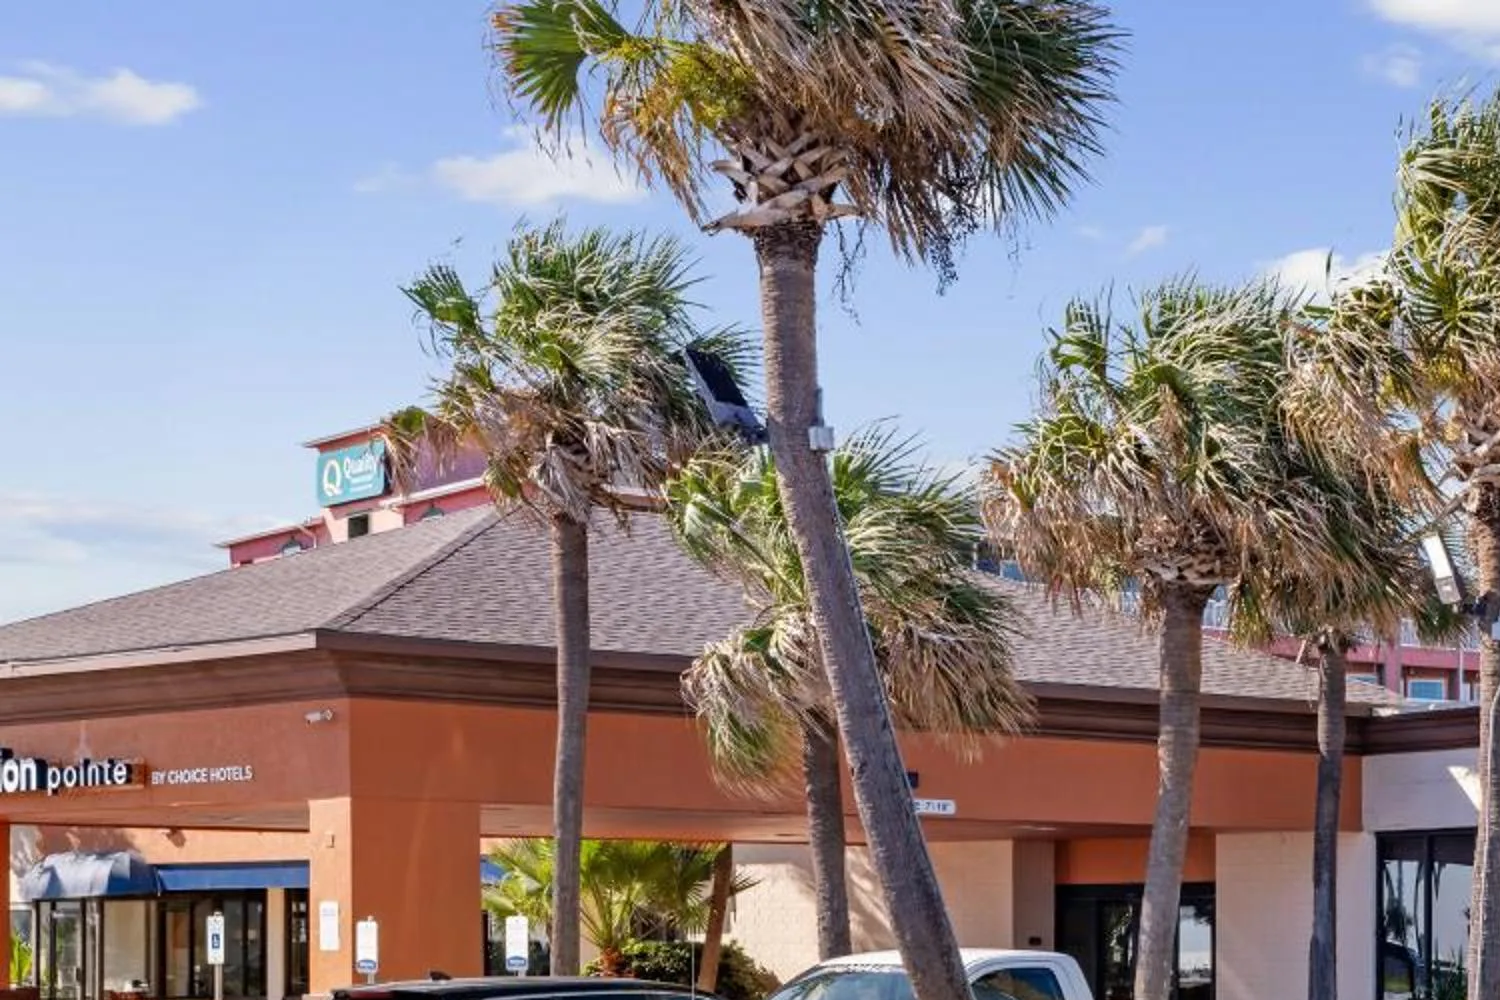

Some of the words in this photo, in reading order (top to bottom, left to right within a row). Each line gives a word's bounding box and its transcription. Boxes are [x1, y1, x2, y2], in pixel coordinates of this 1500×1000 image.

[47, 758, 127, 796] pointe
[152, 771, 168, 785] BY
[168, 767, 209, 784] CHOICE
[211, 765, 253, 782] HOTELS
